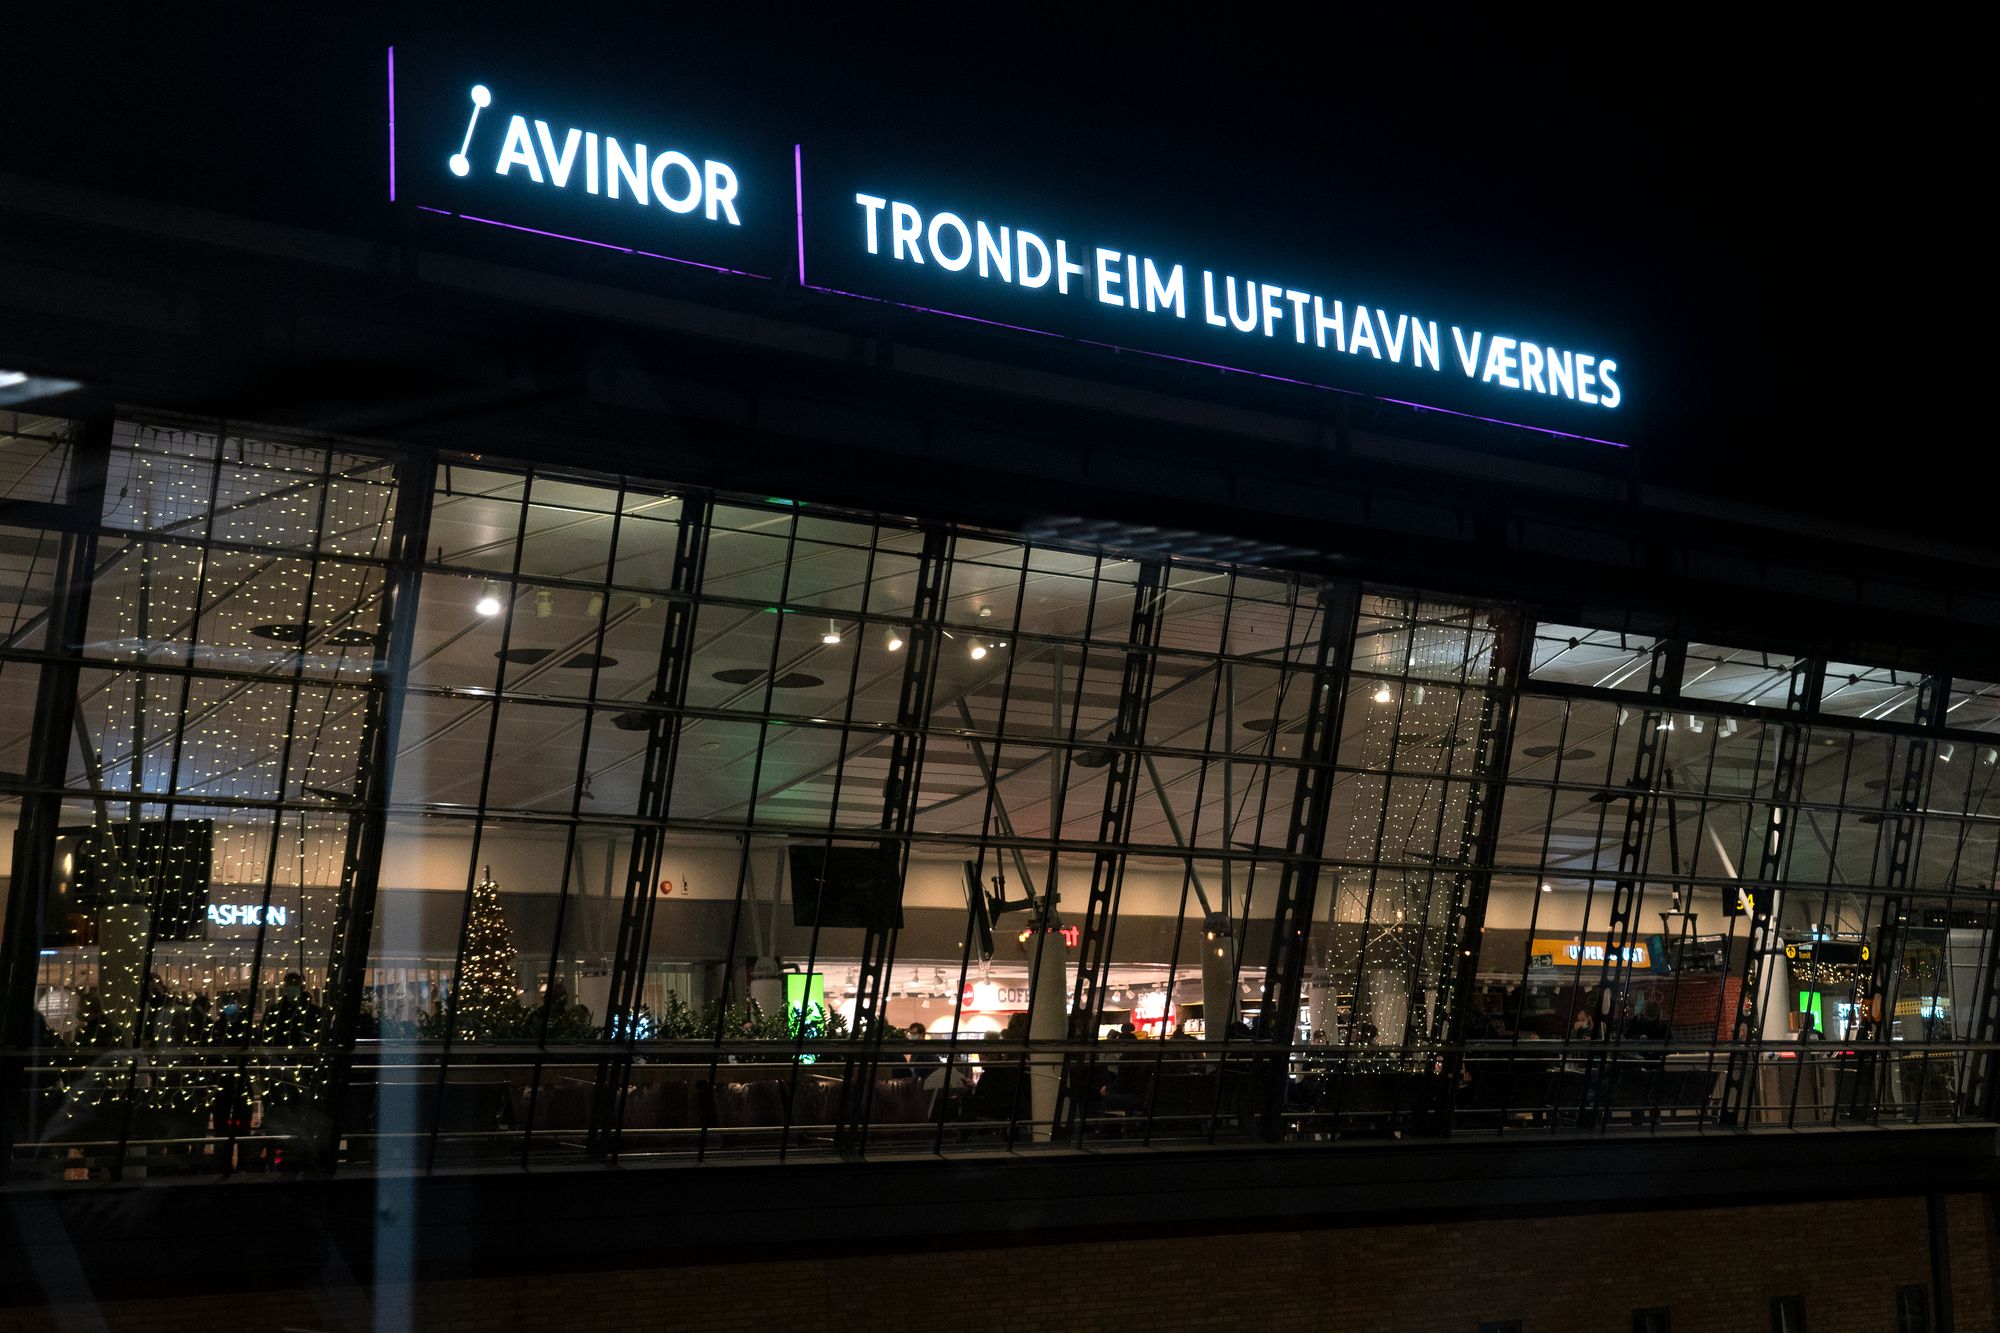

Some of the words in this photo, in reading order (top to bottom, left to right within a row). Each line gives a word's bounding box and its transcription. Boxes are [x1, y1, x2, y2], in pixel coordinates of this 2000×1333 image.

[496, 114, 741, 226] AVINOR
[855, 192, 1186, 319] TRONDHEIM
[1203, 270, 1440, 371] LUFTHAVN
[1452, 325, 1621, 409] VÆRNES
